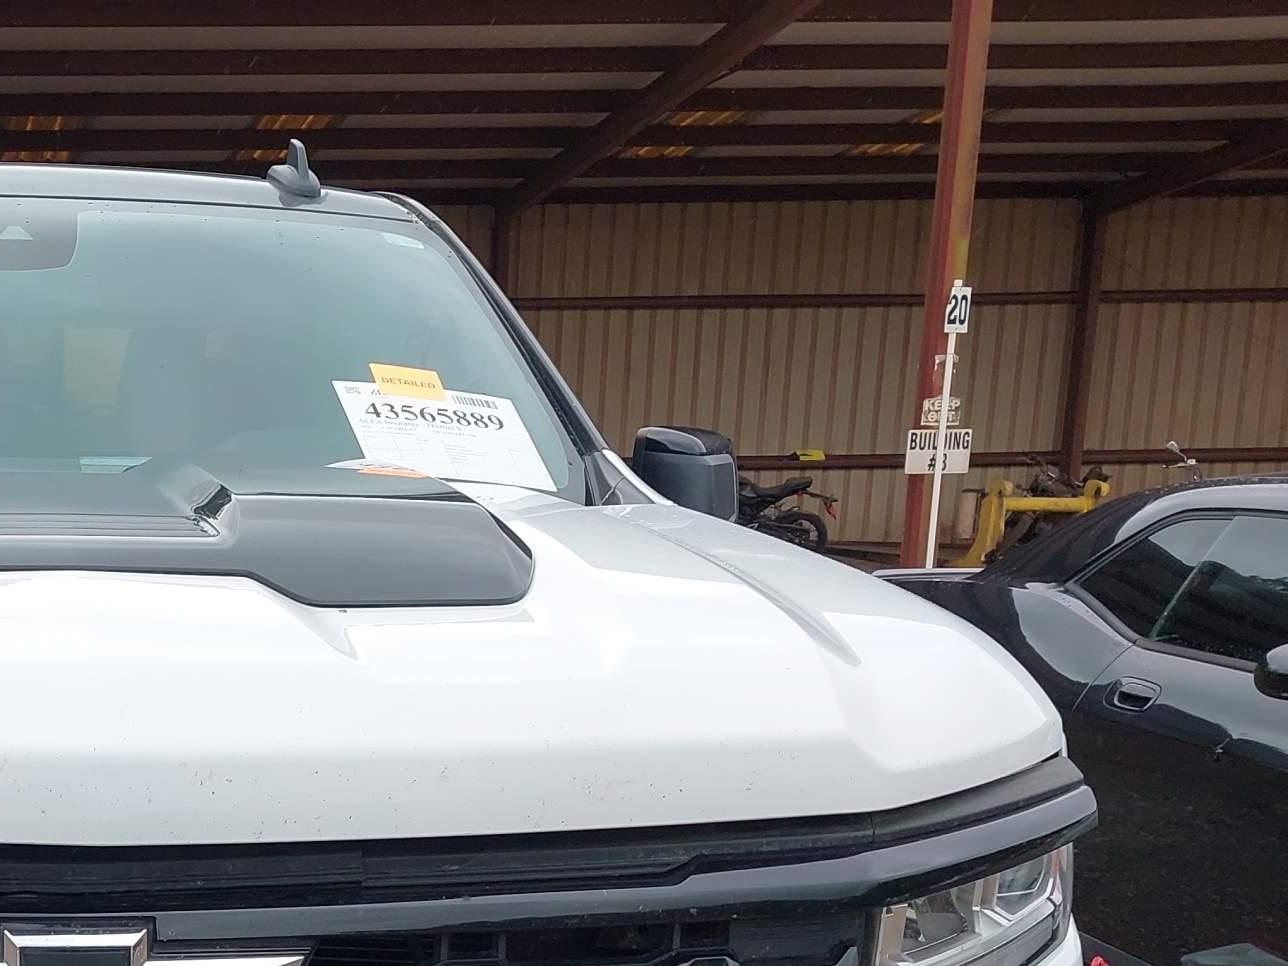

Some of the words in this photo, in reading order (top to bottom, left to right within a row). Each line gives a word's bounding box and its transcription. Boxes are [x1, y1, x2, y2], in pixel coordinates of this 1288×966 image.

[947, 294, 968, 325] 20
[381, 377, 436, 389] DETAILED
[365, 402, 504, 430] 43565889
